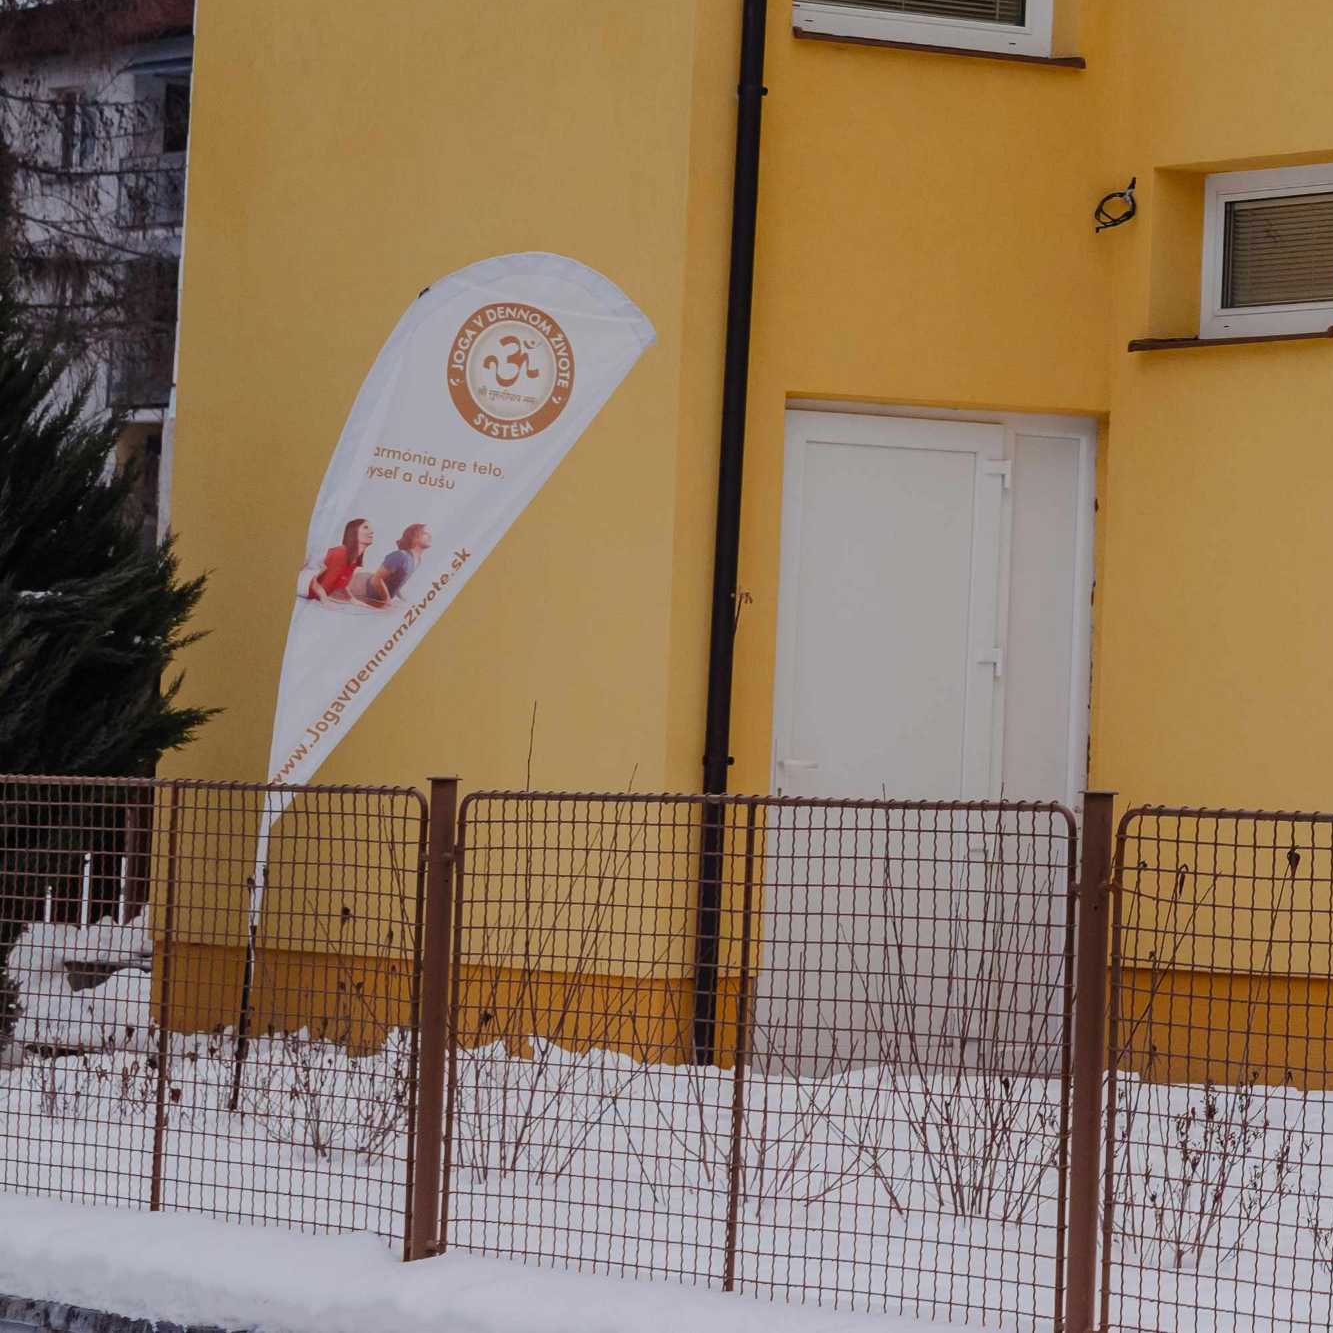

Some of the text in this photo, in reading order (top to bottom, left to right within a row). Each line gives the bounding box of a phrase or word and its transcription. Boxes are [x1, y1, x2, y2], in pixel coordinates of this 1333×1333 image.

[452, 328, 476, 370] JOGA
[472, 314, 485, 328] V
[485, 306, 552, 336] DENNOM
[441, 458, 467, 473] pre
[402, 472, 413, 482] a
[418, 471, 456, 490] dušu
